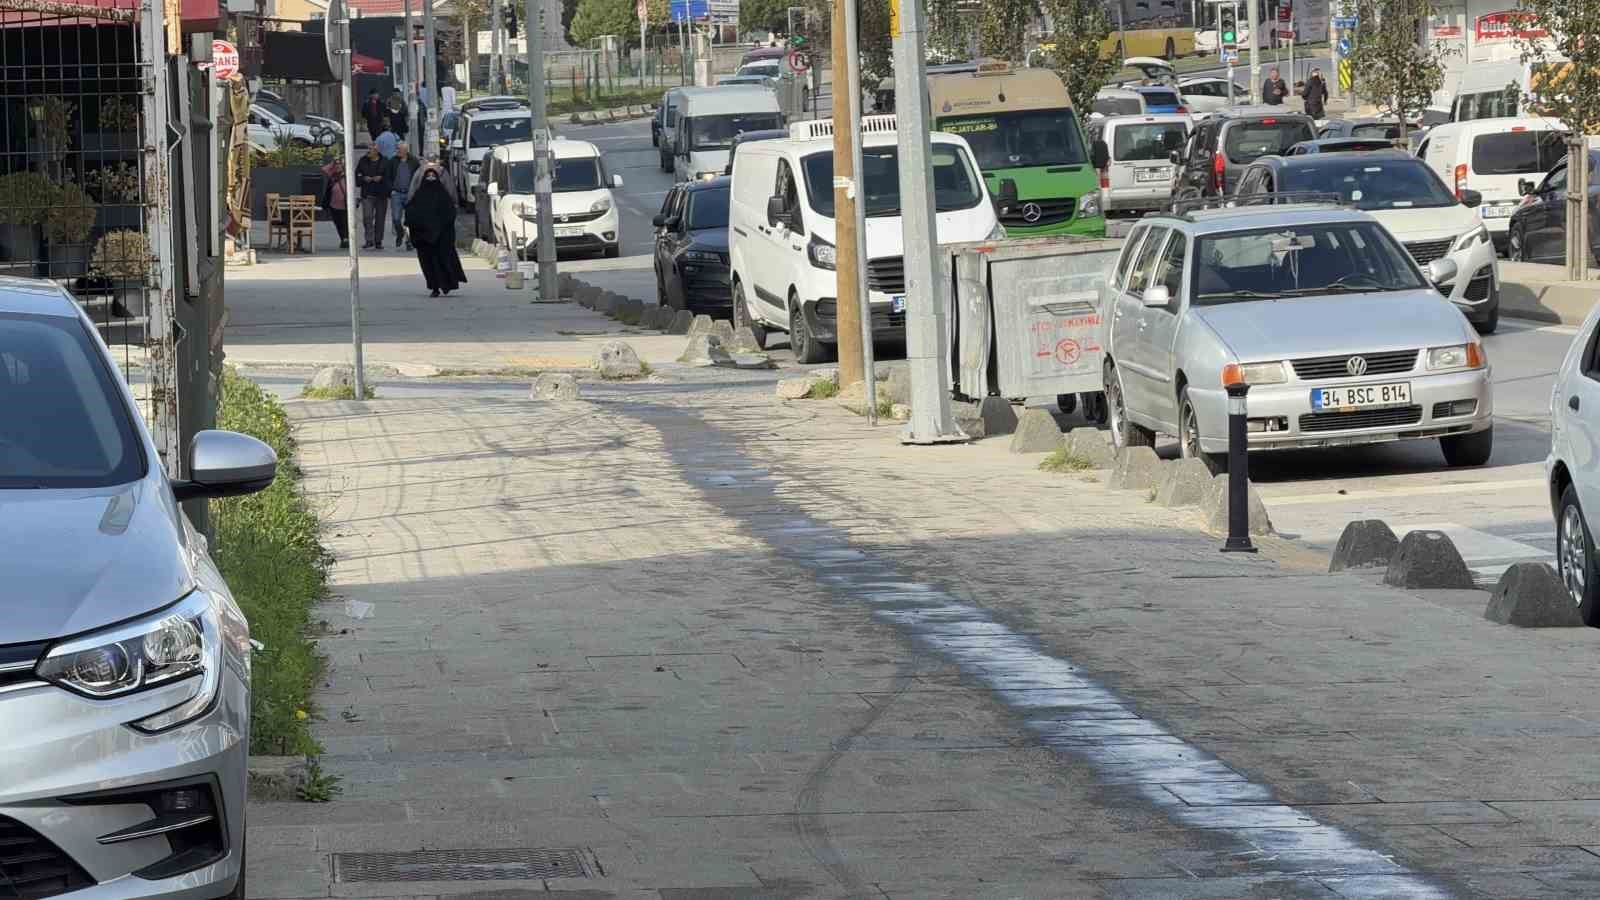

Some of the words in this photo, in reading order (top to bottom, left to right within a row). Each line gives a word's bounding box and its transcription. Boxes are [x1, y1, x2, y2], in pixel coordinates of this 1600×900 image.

[1322, 390, 1340, 407] 34
[1347, 388, 1374, 405] BSC
[1382, 385, 1406, 402] 814
